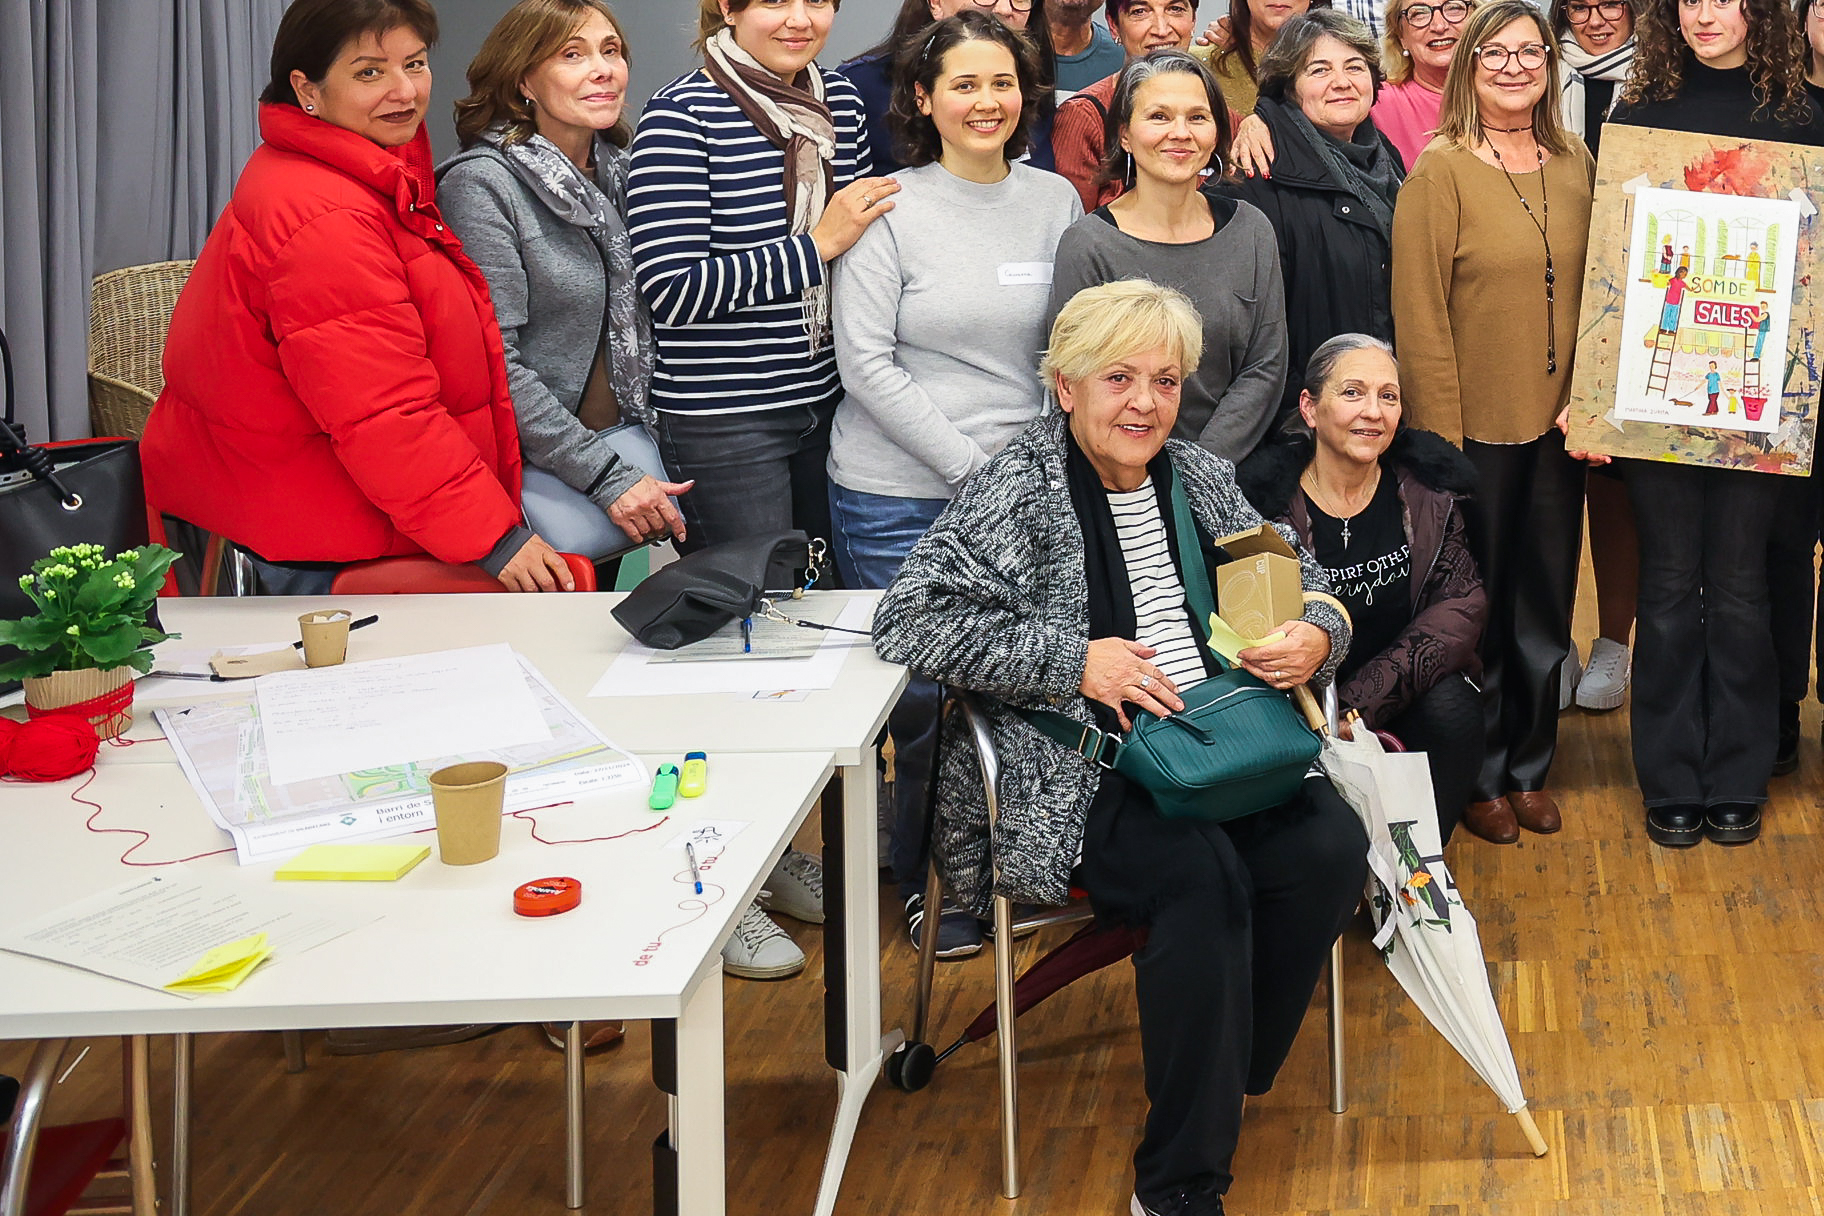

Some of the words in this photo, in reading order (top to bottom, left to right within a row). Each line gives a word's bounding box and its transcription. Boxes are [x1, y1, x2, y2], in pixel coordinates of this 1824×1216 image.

[1692, 277, 1725, 295] SOM
[1729, 282, 1747, 297] DE
[1696, 303, 1753, 328] SALES
[406, 800, 422, 810] de
